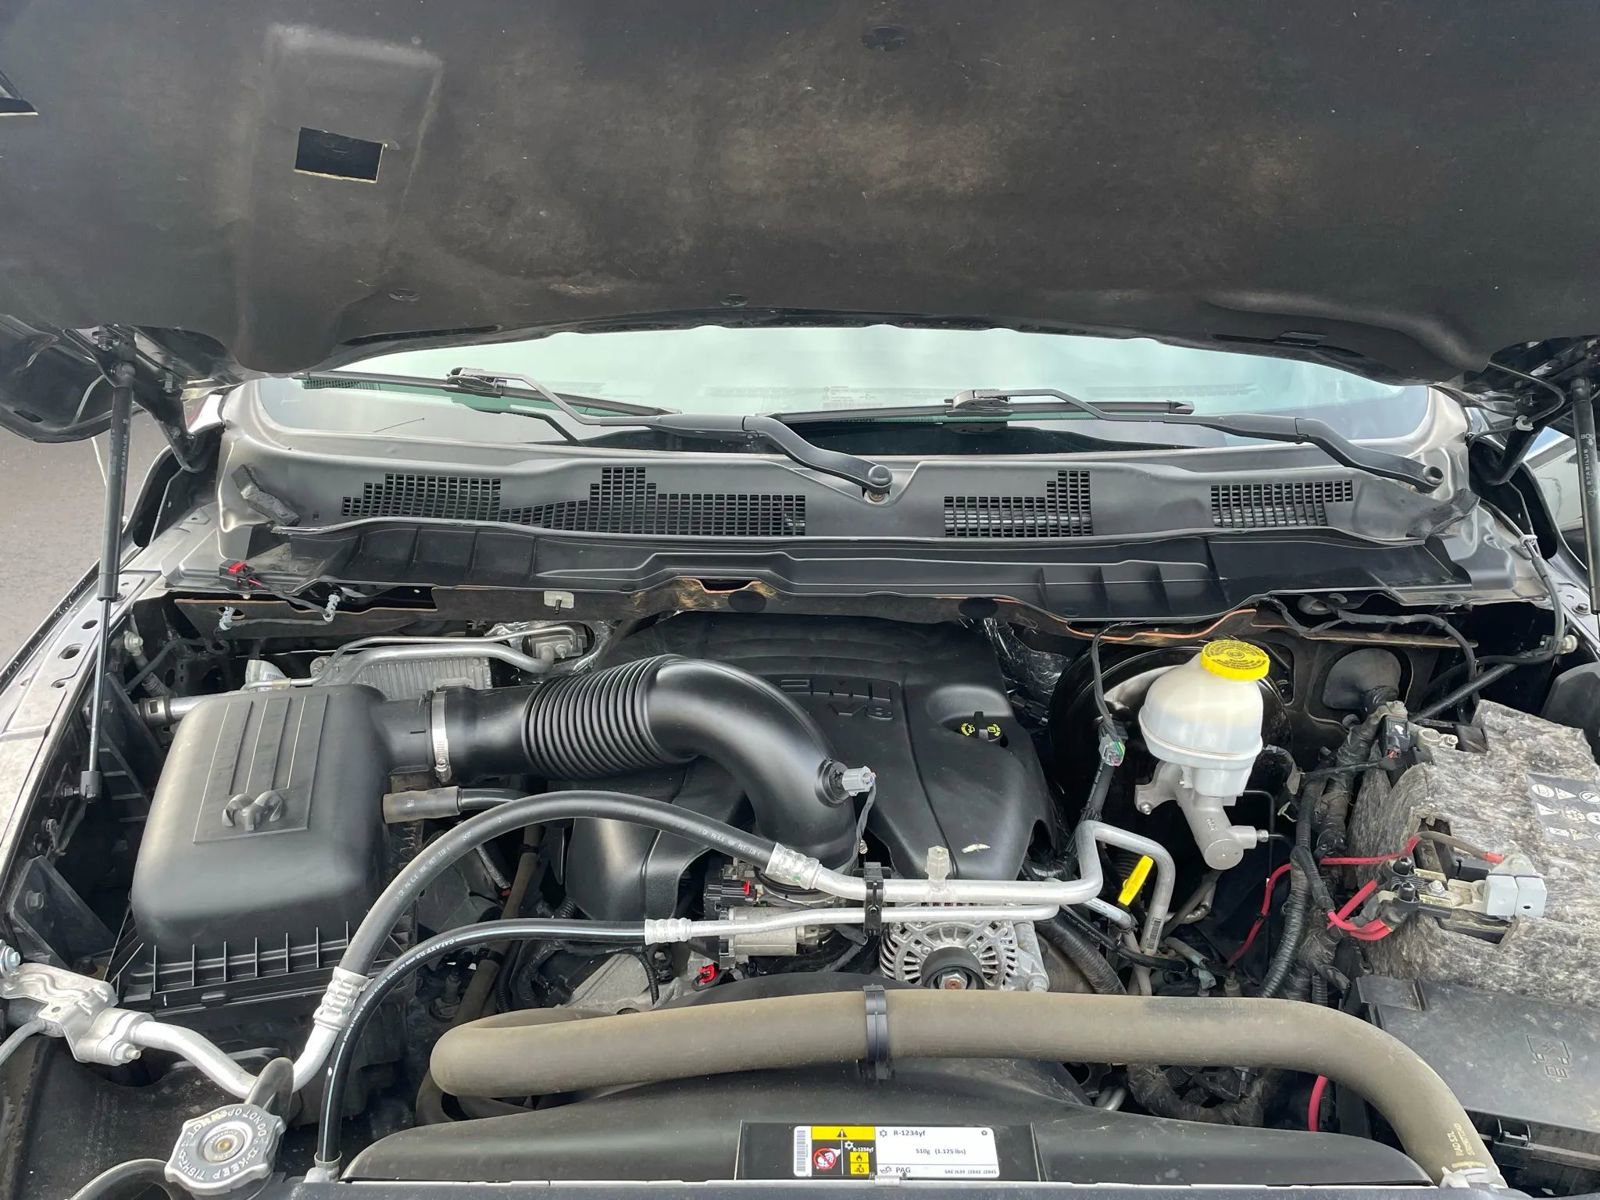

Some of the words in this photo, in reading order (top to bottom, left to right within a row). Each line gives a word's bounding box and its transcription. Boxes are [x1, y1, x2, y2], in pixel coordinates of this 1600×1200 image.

[426, 938, 455, 954] GALAXY
[211, 1107, 242, 1122] OPEN
[243, 1110, 263, 1124] NOT
[893, 1129, 926, 1138] R-1234yf
[212, 1160, 249, 1180] KEEP
[895, 1166, 911, 1174] PAG
